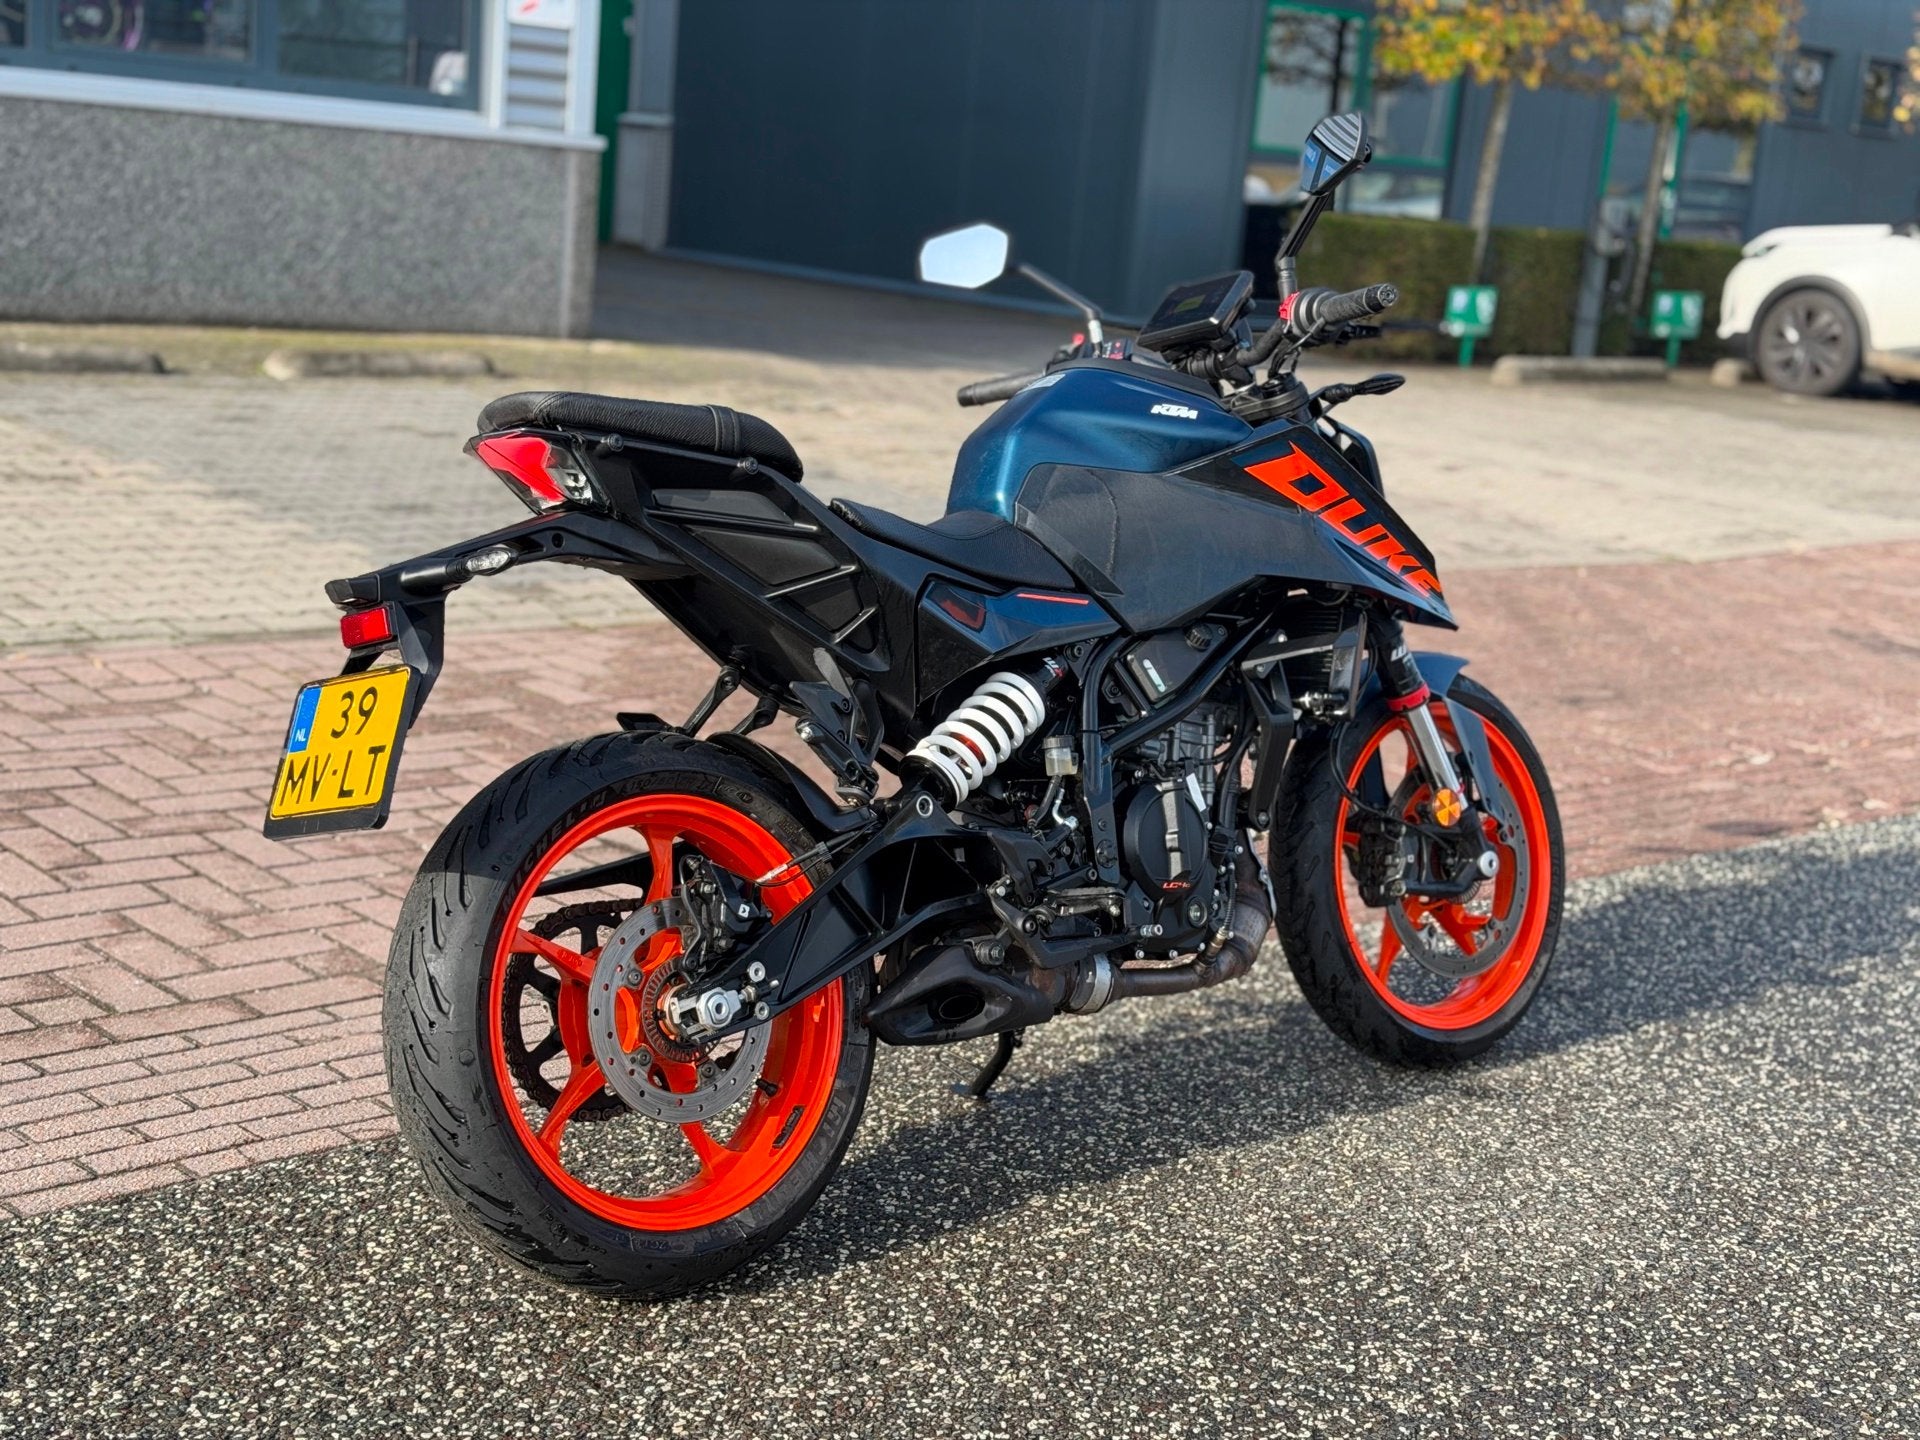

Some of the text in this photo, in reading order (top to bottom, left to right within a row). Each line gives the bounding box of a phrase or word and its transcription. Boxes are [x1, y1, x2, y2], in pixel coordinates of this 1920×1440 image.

[1150, 403, 1198, 419] KTM
[1243, 440, 1442, 597] DUKE
[295, 728, 307, 742] NL
[330, 686, 378, 739] 39
[501, 790, 607, 912] MICHELIN
